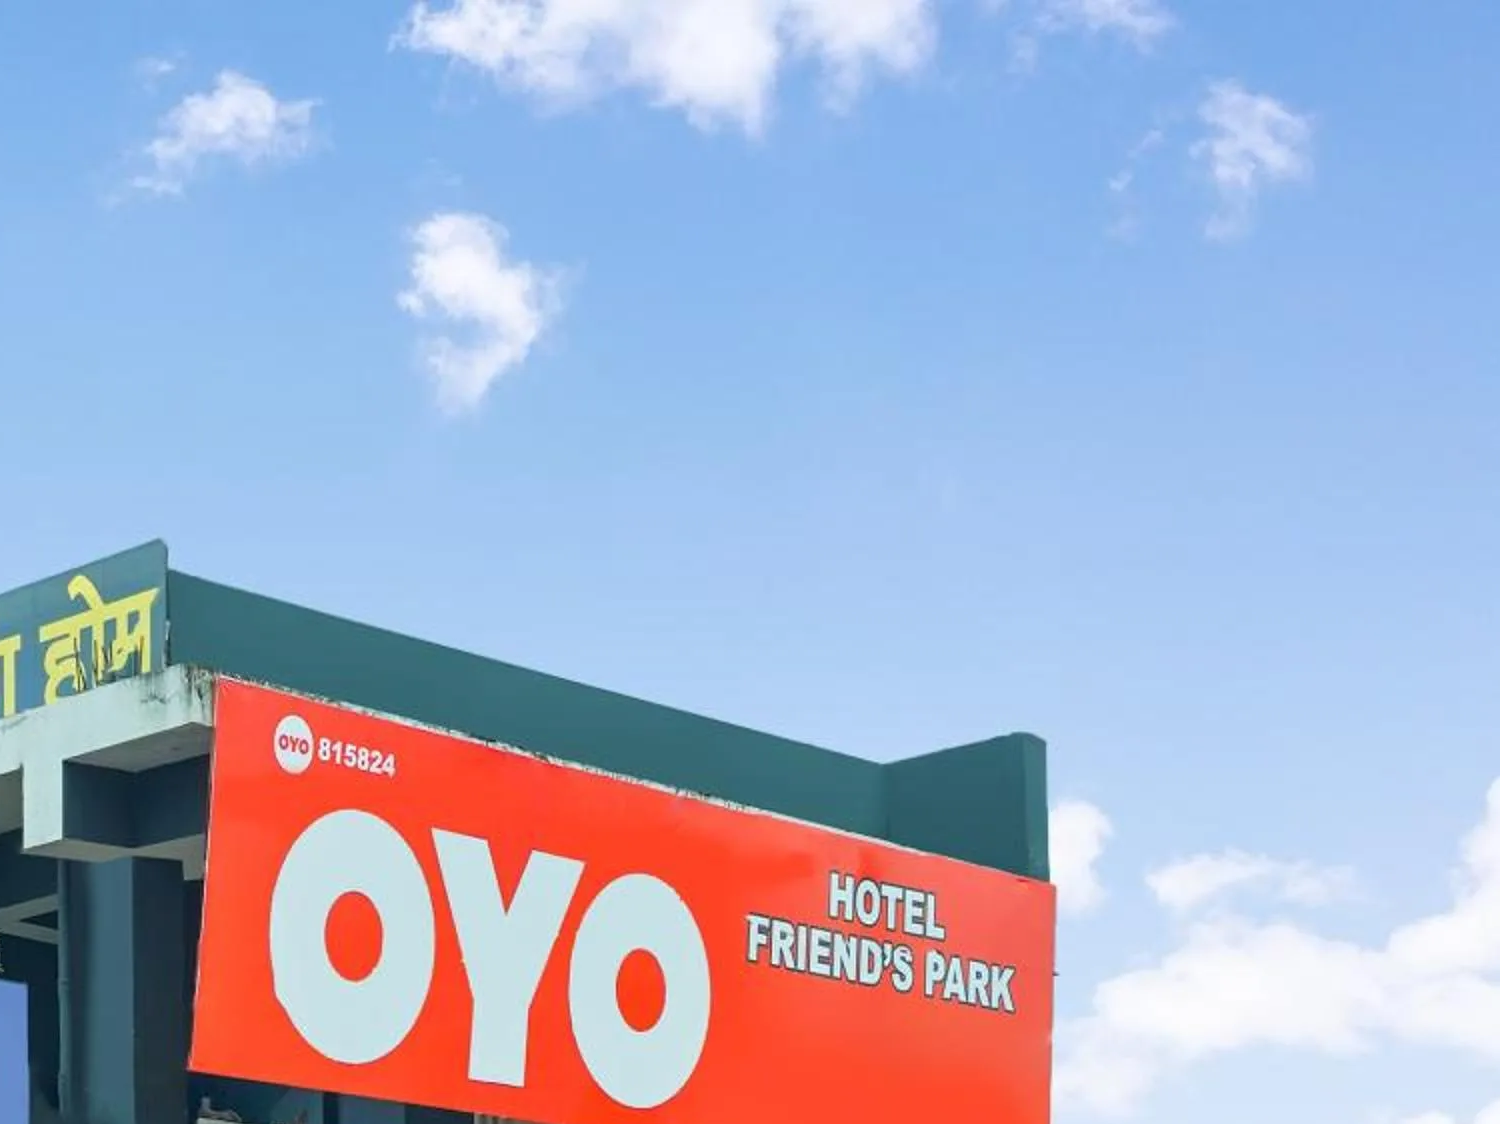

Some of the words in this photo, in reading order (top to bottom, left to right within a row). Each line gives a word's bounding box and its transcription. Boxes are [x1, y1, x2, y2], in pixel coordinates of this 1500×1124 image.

[40, 574, 160, 705] होम
[279, 734, 309, 755] OYO
[318, 737, 396, 777] 815824
[829, 870, 946, 941] HOTEL
[269, 809, 711, 1109] OYO
[746, 912, 913, 992] FRIEND'S
[924, 949, 1015, 1013] PARK
